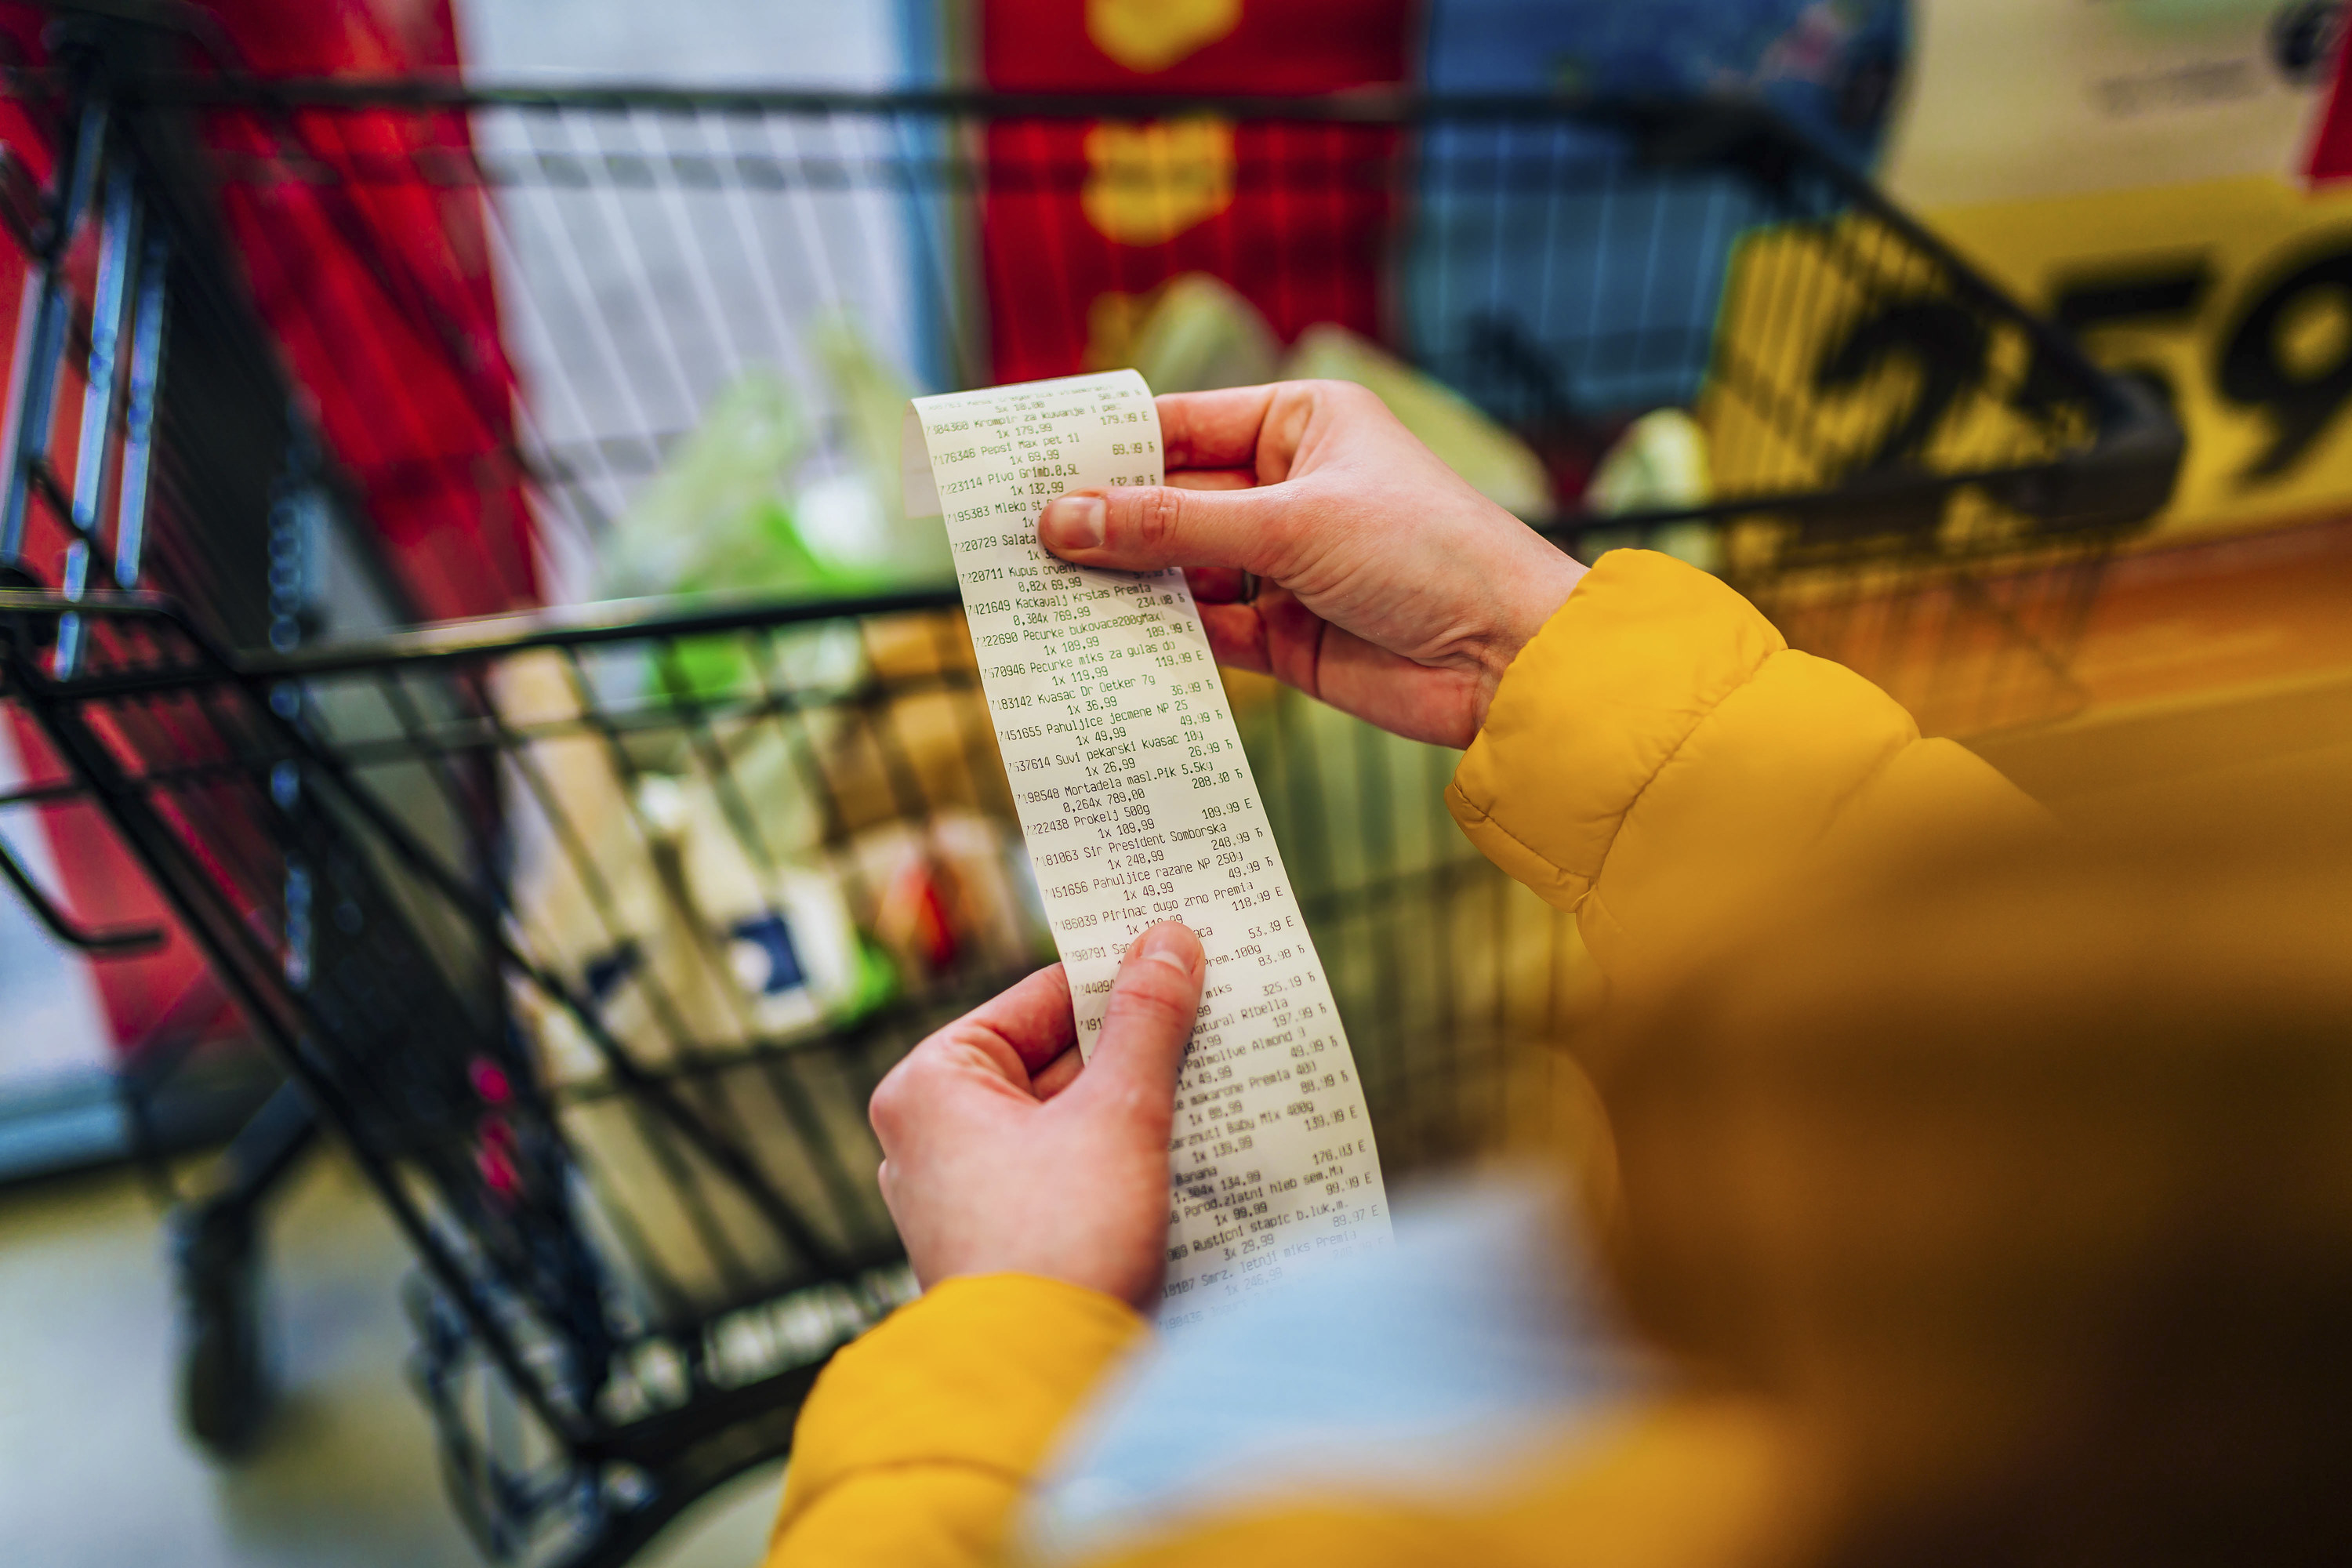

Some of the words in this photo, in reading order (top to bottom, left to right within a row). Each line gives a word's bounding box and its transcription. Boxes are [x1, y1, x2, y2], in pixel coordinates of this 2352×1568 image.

[1029, 481, 1064, 495] 132,99
[995, 501, 1026, 514] Mleko
[1022, 517, 1034, 528] 1x
[1002, 533, 1036, 546] Salata
[1027, 550, 1040, 561] 1x
[1008, 567, 1038, 578] Kupus
[1051, 576, 1082, 590] 69,99
[1015, 595, 1068, 609] Kackavalj
[1073, 590, 1110, 603] Krstas
[1053, 606, 1091, 622] 769,99
[1023, 629, 1064, 641] Pecurke
[1044, 644, 1057, 655] 1x
[1062, 637, 1099, 653] 109,99
[1030, 659, 1073, 673] Pecurke
[1078, 652, 1104, 665] miks
[1109, 649, 1123, 659] za
[1127, 644, 1158, 657] gulas
[1052, 676, 1065, 686] 1x
[1070, 666, 1109, 682] 119,99
[1037, 690, 1076, 704] Kvasac
[1080, 686, 1093, 696] Dr
[1099, 678, 1136, 692] Oetker
[1142, 674, 1156, 685] 7g
[1067, 705, 1080, 715] 1x
[1085, 695, 1118, 712] 36,99
[1047, 717, 1103, 734] Pahuljice
[1109, 708, 1152, 724] jecmene
[1156, 702, 1170, 714] NP
[1174, 699, 1188, 711] 25
[1076, 735, 1090, 746] 1x
[1094, 727, 1127, 742] 49,99
[1055, 752, 1081, 765] Suvi
[1087, 741, 1137, 761] pekarski
[1142, 735, 1180, 750] kvasac
[1085, 766, 1099, 777] 1x
[1103, 757, 1136, 773] 26,99
[1065, 778, 1122, 797] Mortadela
[1127, 767, 1177, 785] masl.Pik
[1181, 761, 1214, 775] 5.5kg
[1063, 797, 1102, 813] 0,264x
[1106, 788, 1145, 804] 789,00
[1073, 809, 1120, 826] Prokelj
[1123, 804, 1151, 818] 500g
[1098, 828, 1112, 839] 1x
[1116, 818, 1155, 836] 109,99
[1244, 798, 1253, 809] E
[1083, 846, 1103, 858] Sir
[1109, 833, 1166, 853] President
[1170, 823, 1227, 842] Somborska
[1107, 859, 1121, 869] 1x
[1126, 850, 1164, 866] 248,99
[1093, 870, 1151, 889] Pahuljice
[1156, 863, 1193, 877] razane
[1197, 858, 1210, 870] NP
[1216, 851, 1243, 866] 250g
[1123, 889, 1137, 901] 1x
[1142, 881, 1174, 896] 49,99
[1102, 906, 1148, 922] Pirinac
[1153, 900, 1178, 913] dugo
[1184, 894, 1209, 906] zrno
[1214, 882, 1254, 900] Premia
[1126, 924, 1140, 935] 1x
[1275, 886, 1283, 897] E
[1286, 916, 1294, 927] E
[1205, 984, 1232, 999] miks
[1240, 998, 1289, 1020] Ribella
